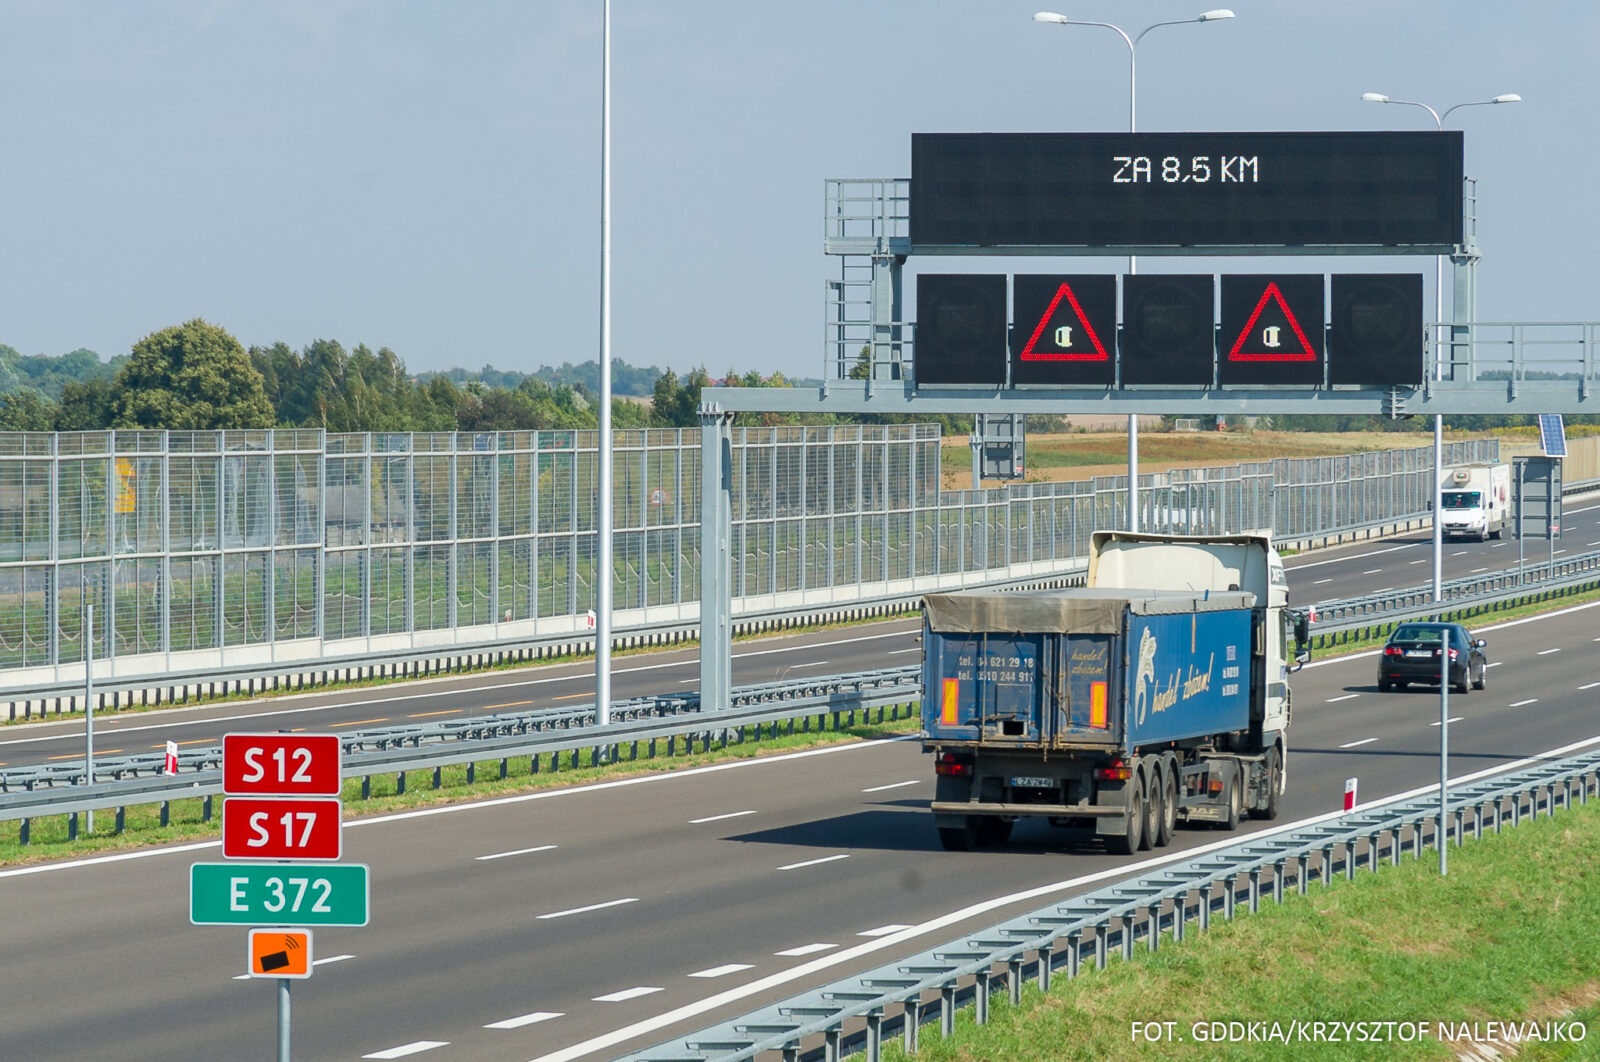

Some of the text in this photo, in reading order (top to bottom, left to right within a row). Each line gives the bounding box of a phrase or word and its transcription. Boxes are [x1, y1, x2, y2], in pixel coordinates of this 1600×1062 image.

[1113, 156, 1258, 183] ZA 8,5 KM
[959, 655, 974, 667] tel.
[990, 657, 1005, 668] 621
[1008, 657, 1020, 668] 29
[1023, 657, 1034, 668] 18
[958, 670, 973, 681] tel.
[1000, 671, 1015, 681] 244
[230, 877, 332, 913] E 372
